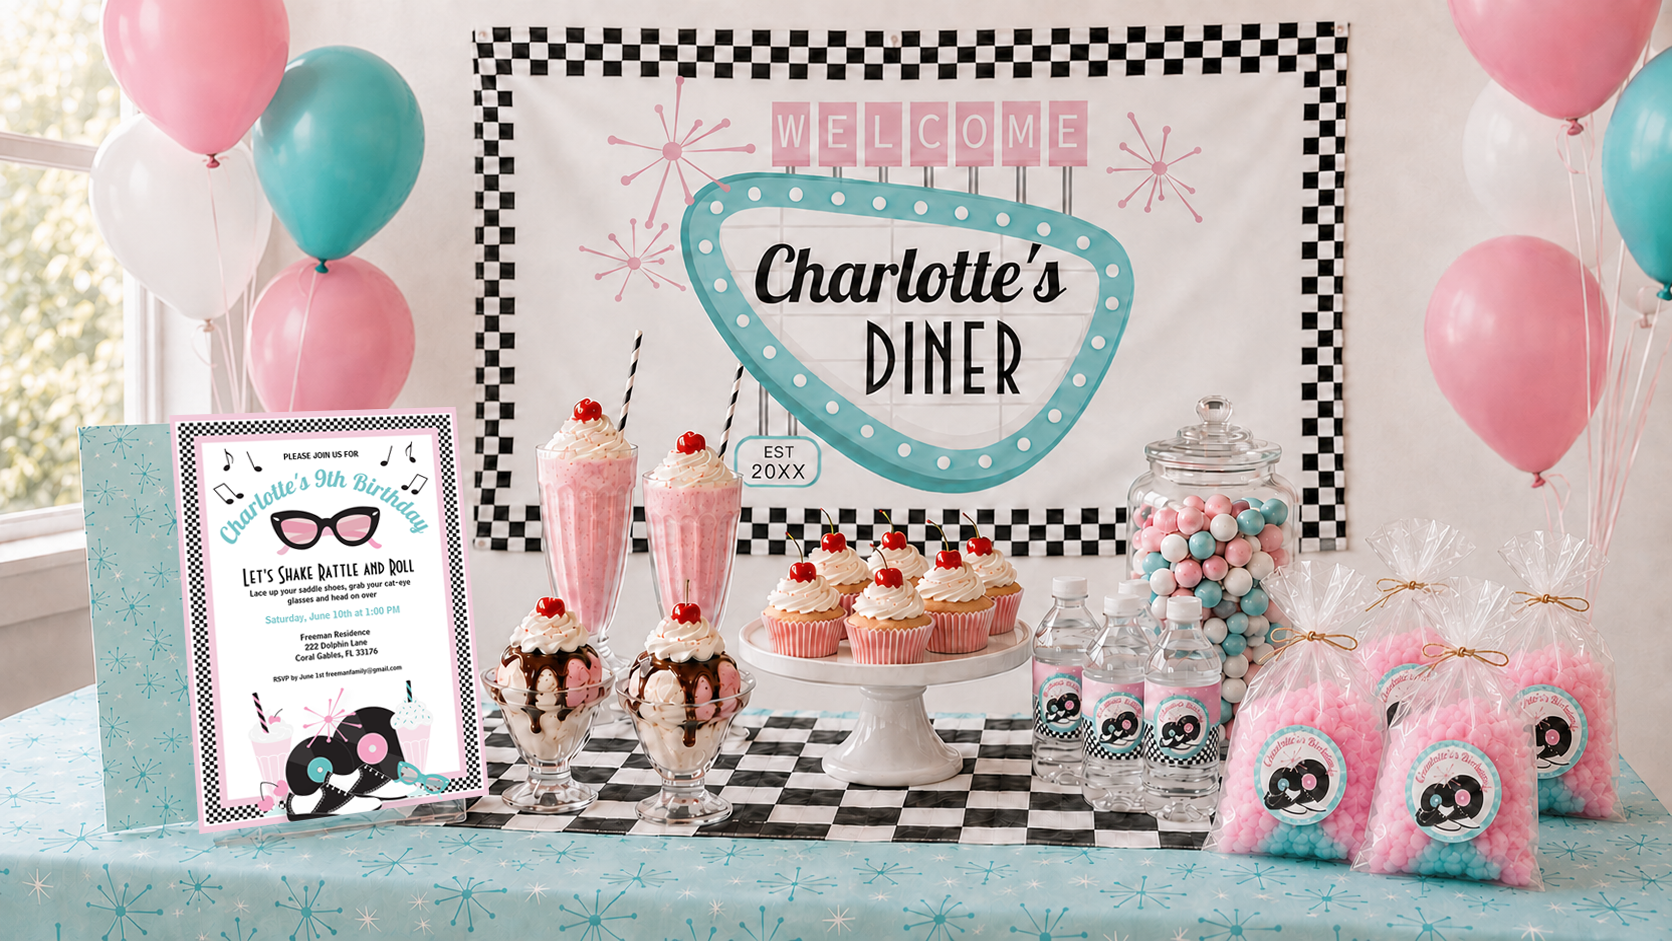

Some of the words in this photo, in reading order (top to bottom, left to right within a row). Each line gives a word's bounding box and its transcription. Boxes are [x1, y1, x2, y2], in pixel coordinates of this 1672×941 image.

[778, 114, 1078, 149] WELCOME
[754, 242, 1067, 303] Charlotte's
[866, 320, 1022, 395] DINER
[283, 452, 311, 460] PLEASE
[313, 451, 330, 459] JOIN
[344, 450, 359, 458] FOR
[763, 446, 794, 458] EST
[751, 463, 806, 480] 20XX
[220, 473, 310, 544] Charlotte's
[315, 469, 347, 488] 9th
[353, 473, 429, 534] Birthday
[280, 588, 297, 596] your
[299, 585, 322, 594] saddle
[324, 583, 347, 592] shoes,
[349, 582, 365, 590] grab
[384, 579, 411, 587] cat-eye
[287, 596, 314, 605] glasses
[331, 593, 348, 601] head
[265, 613, 307, 625] Saturday,
[309, 611, 330, 621] June
[333, 609, 352, 619] 10th
[354, 608, 363, 617] at
[365, 607, 384, 616] 1:00
[387, 605, 400, 614] PM
[300, 631, 332, 641] Freeman
[334, 628, 370, 638] Residence
[304, 643, 319, 651] 222
[321, 640, 349, 650] Dolphin
[350, 639, 368, 647] Lane
[295, 654, 315, 662] Coral
[317, 651, 343, 660] Gables,
[356, 648, 378, 656] 33176
[299, 672, 314, 680] June
[325, 665, 402, 677] freemanfamily@gmail.com
